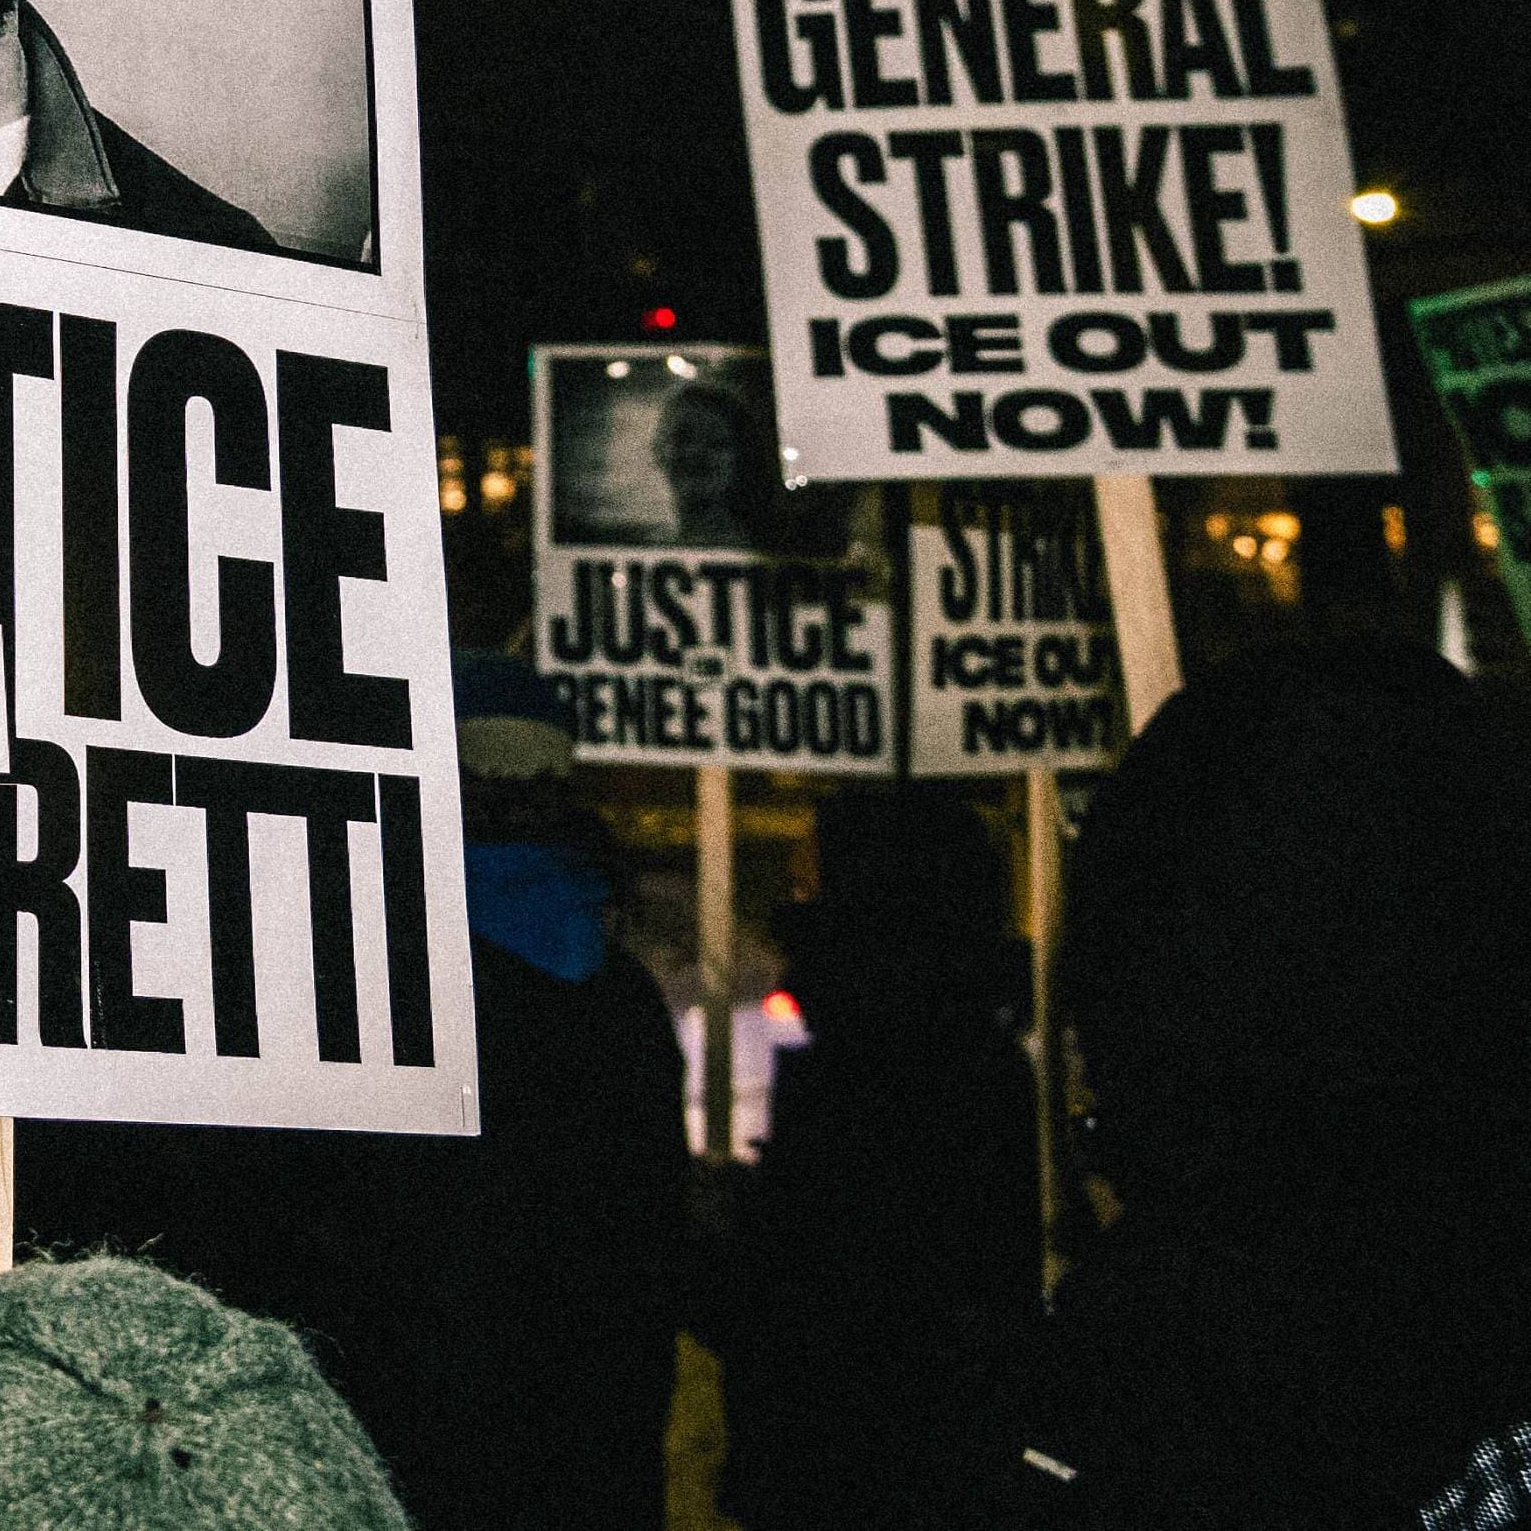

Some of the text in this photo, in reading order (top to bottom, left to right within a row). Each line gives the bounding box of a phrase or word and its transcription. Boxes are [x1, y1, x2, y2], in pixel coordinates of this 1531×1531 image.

[805, 122, 1303, 302] STRIKE!
[809, 310, 1337, 378] ICE OUT
[886, 387, 1279, 454] NOW!
[549, 557, 876, 674] JUSTICE
[931, 633, 1026, 690] ICE
[725, 676, 882, 758] GOOD
